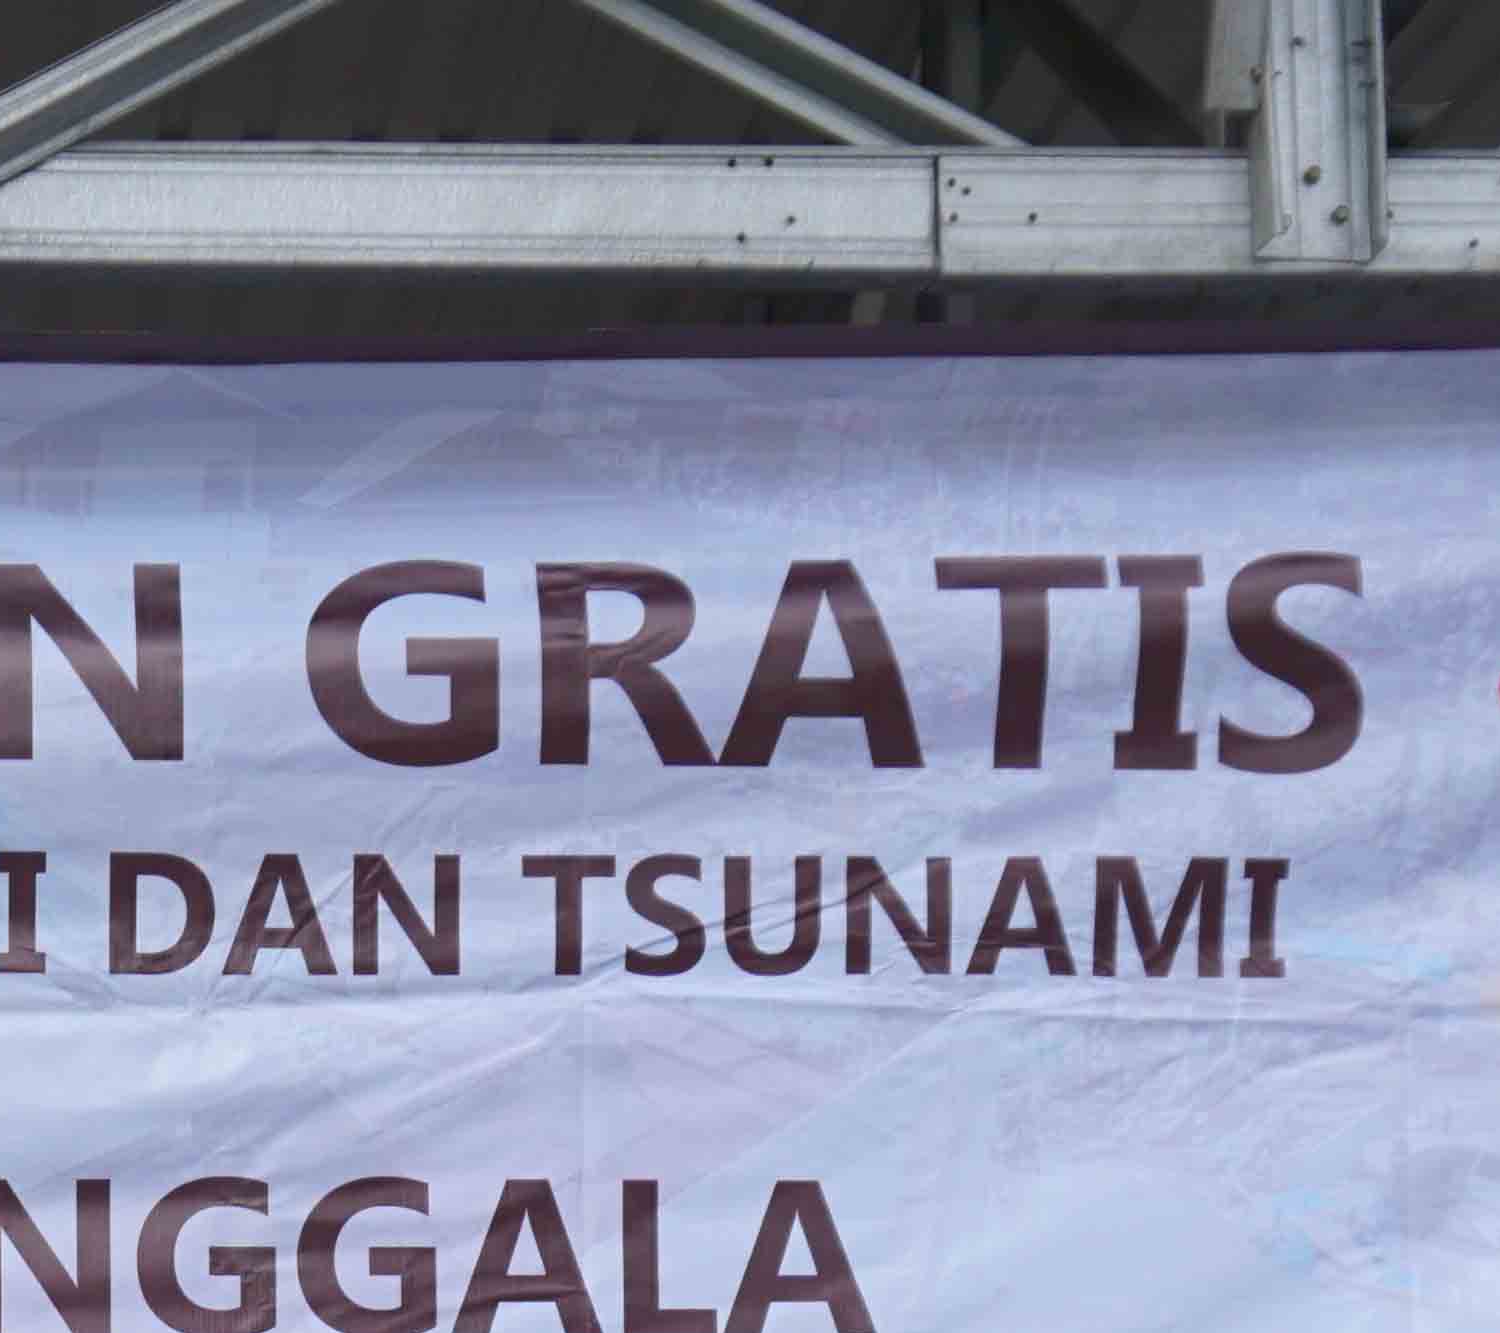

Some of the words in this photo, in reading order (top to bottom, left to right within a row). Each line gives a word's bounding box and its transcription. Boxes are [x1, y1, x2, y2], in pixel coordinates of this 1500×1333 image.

[309, 555, 1361, 773] GRATIS
[110, 853, 459, 975] DAN
[523, 855, 1288, 977] TSUNAMI
